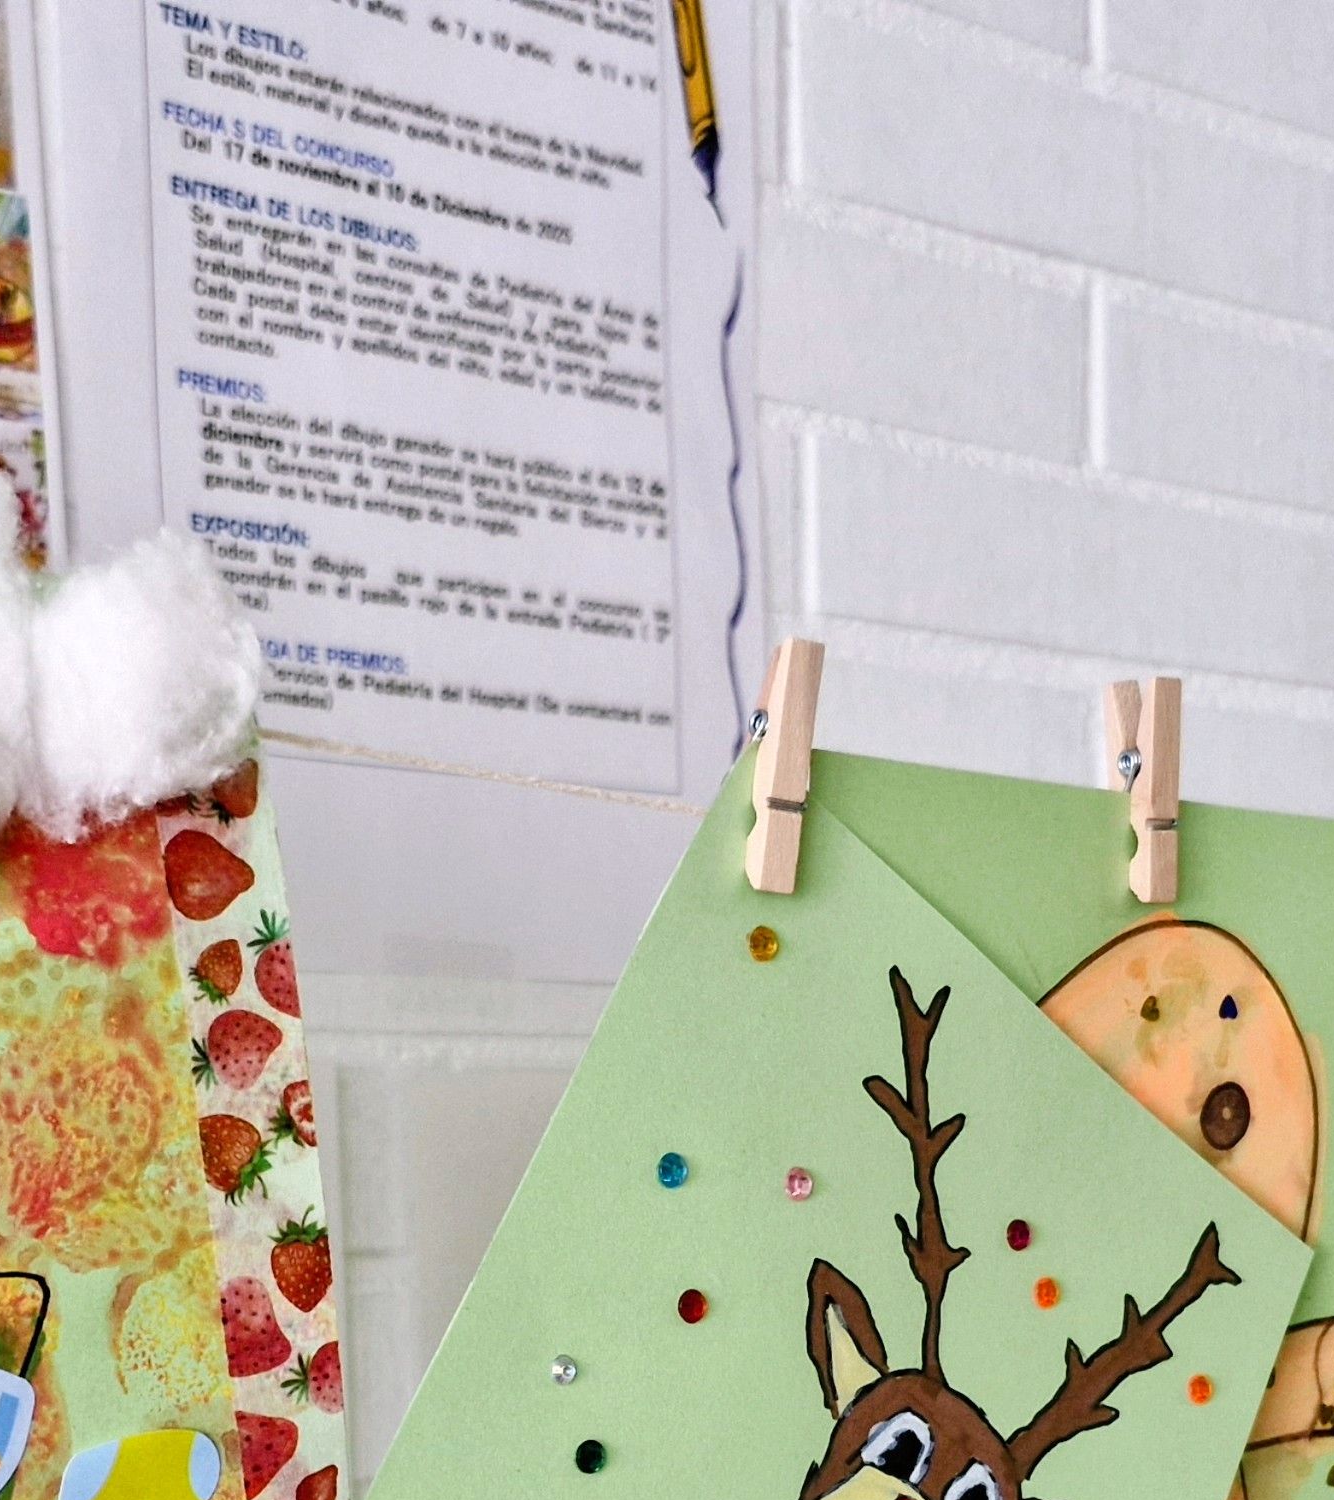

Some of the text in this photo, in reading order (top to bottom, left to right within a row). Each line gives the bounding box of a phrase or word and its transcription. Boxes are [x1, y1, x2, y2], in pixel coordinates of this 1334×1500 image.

[160, 4, 211, 31] TEMA
[218, 21, 232, 39] Y
[162, 102, 226, 132] FECHA
[252, 125, 286, 149] DEL
[294, 135, 394, 177] CONCURSO
[171, 176, 259, 211] ENTREGA
[267, 199, 290, 220] DE
[298, 207, 335, 231] LOS
[220, 569, 296, 590] xpondrán
[296, 644, 318, 663] DE
